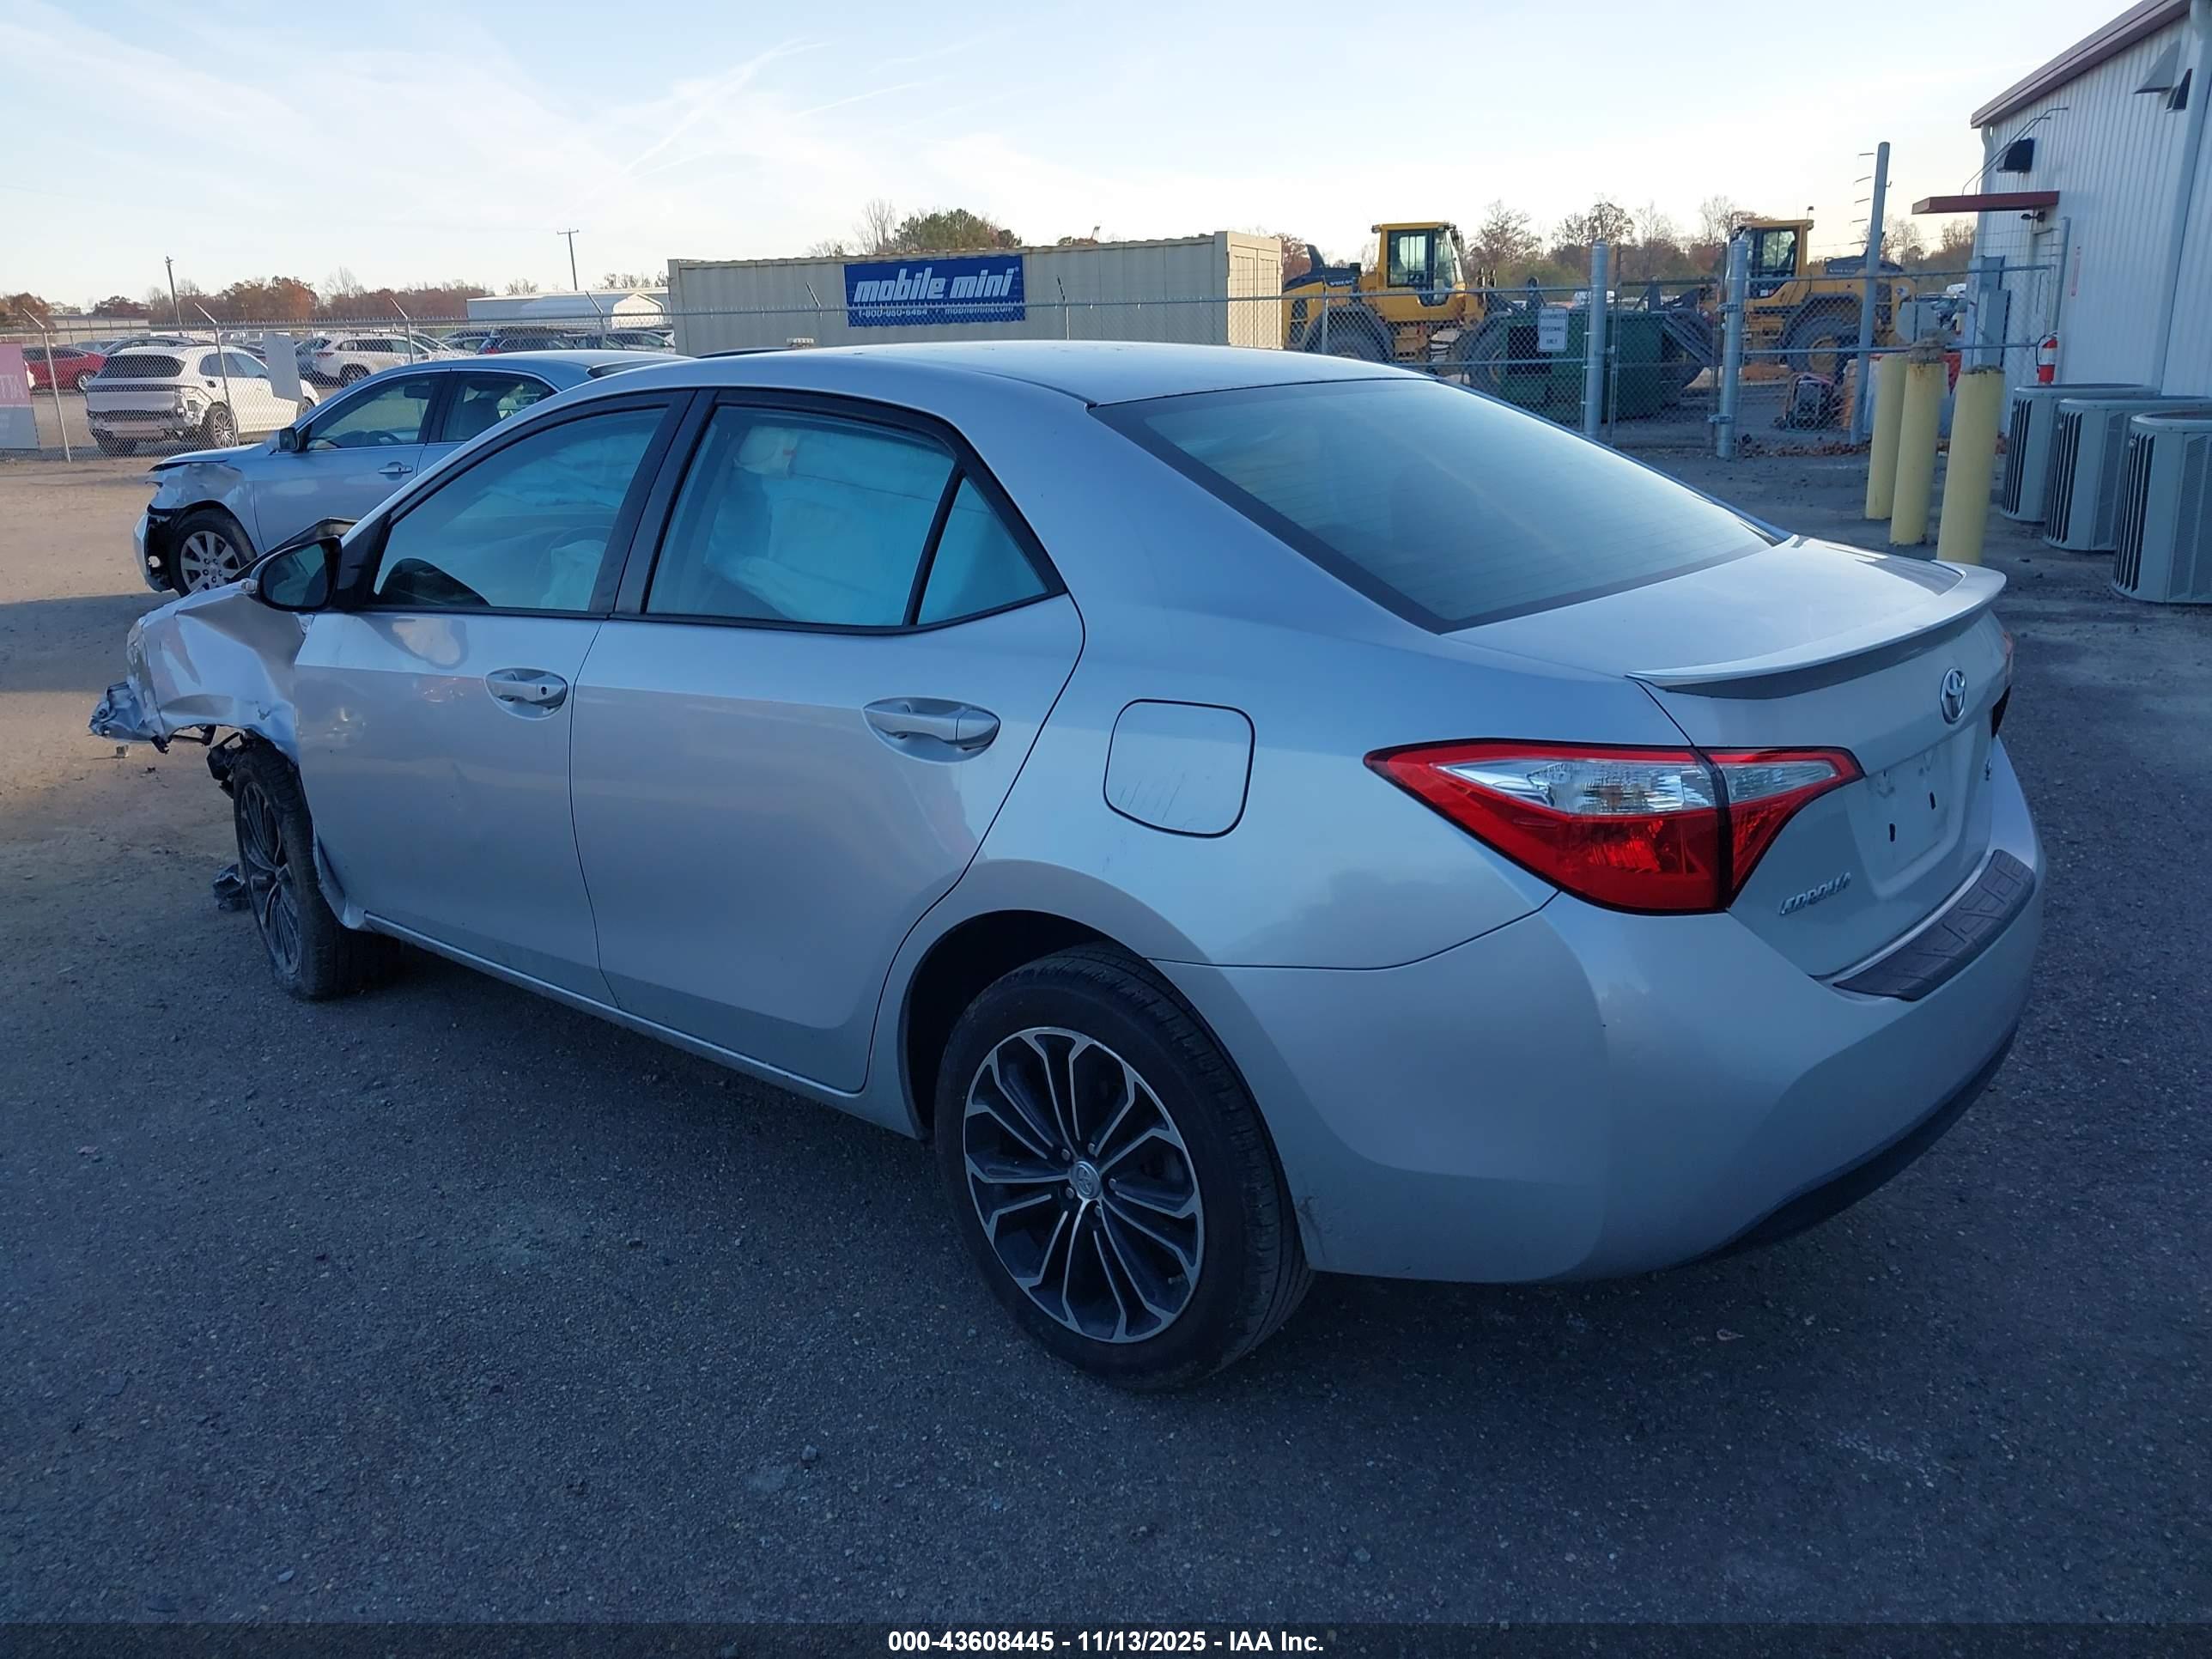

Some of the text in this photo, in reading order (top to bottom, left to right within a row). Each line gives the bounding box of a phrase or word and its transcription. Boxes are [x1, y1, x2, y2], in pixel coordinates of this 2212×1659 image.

[854, 267, 1014, 302] mobile mini
[1778, 872, 1850, 915] COROLLA
